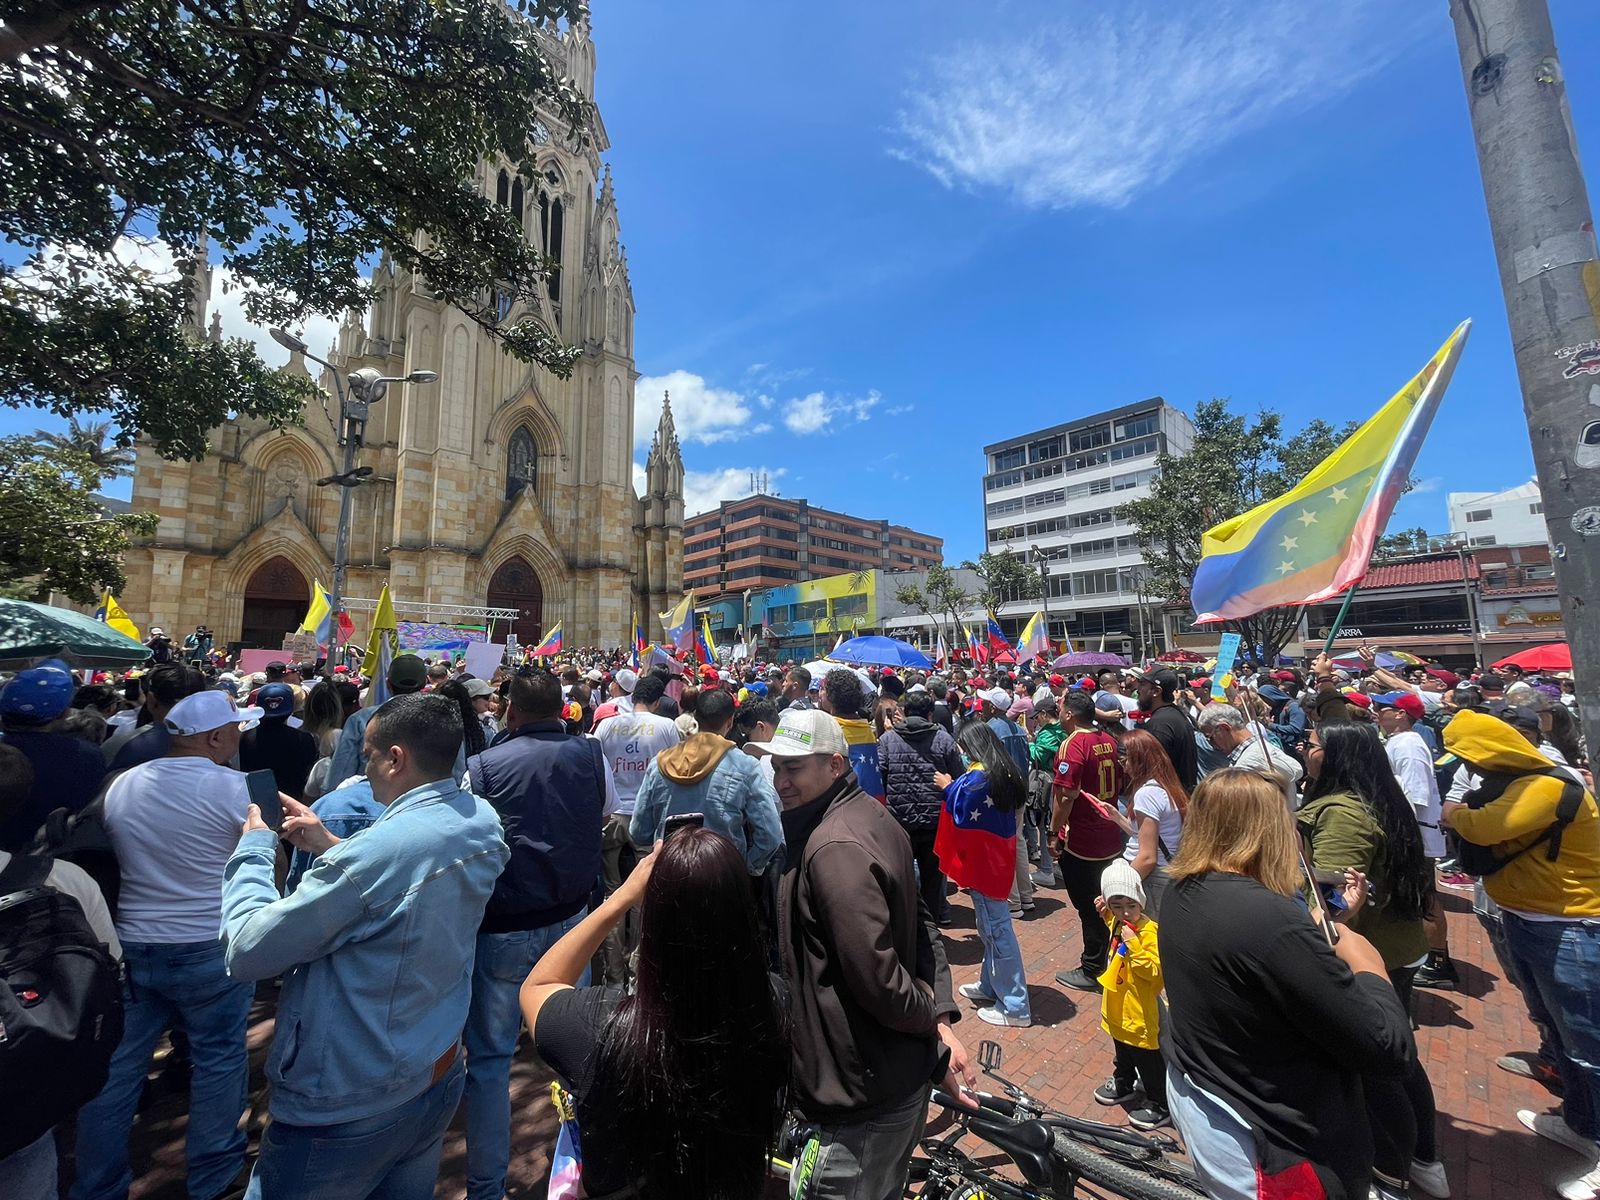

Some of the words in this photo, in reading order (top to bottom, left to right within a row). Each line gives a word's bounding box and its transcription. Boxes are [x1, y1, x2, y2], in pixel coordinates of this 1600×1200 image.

[612, 722, 655, 736] Hasta
[625, 741, 640, 754] el
[615, 757, 648, 772] final
[1098, 759, 1116, 800] 10
